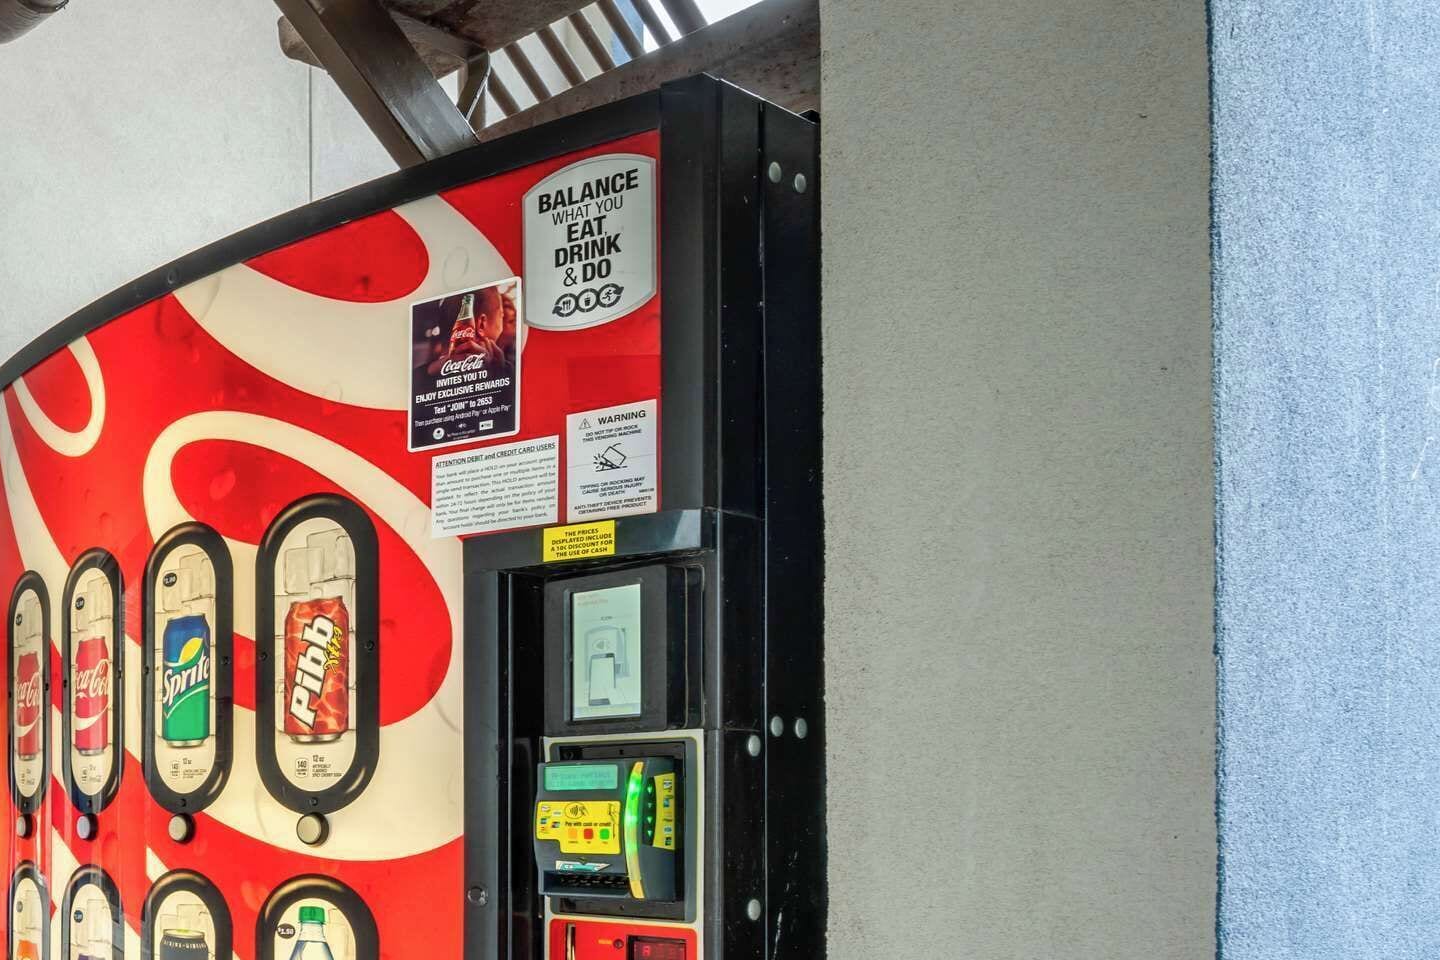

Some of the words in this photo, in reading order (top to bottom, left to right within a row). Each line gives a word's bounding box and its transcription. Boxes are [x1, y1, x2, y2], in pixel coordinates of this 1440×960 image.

[538, 168, 639, 214] BALANCE
[552, 204, 591, 226] WHAT
[596, 195, 623, 214] YOU
[567, 215, 608, 243] EAT,
[555, 233, 622, 268] DRINK
[563, 267, 578, 286] &
[582, 258, 611, 282] DO
[441, 353, 485, 376] Coca-Cola
[436, 375, 462, 388] INVITES
[463, 372, 477, 384] YOU
[478, 370, 487, 380] TO
[415, 392, 436, 403] ENJOY
[438, 385, 474, 399] EXCLUSIVE
[475, 378, 510, 391] REWARDS
[434, 405, 446, 414] Text
[470, 400, 476, 408] to
[477, 396, 493, 407] 2653
[454, 410, 471, 419] Android
[488, 405, 500, 415] Apple
[597, 409, 646, 425] WARNING
[595, 432, 617, 440] VENDING
[618, 428, 642, 436] MACHINE
[435, 457, 466, 468] ATTENTION
[466, 454, 483, 463] DEBIT
[484, 452, 495, 460] and
[496, 449, 517, 458] CREDIT
[518, 446, 535, 455] CARD
[536, 442, 555, 452] USERS
[600, 484, 623, 492] SERIOUS
[574, 502, 602, 510] ANTI-THEFT
[623, 495, 652, 503] PREVENTS
[621, 501, 647, 509] PRODUCT
[551, 537, 585, 546] DISPLAYED
[585, 533, 612, 541] INCLUDE
[577, 528, 599, 536] PRICES
[568, 541, 599, 550] DISCOUNT
[163, 653, 209, 706] Sprite
[289, 614, 335, 730] Pibb
